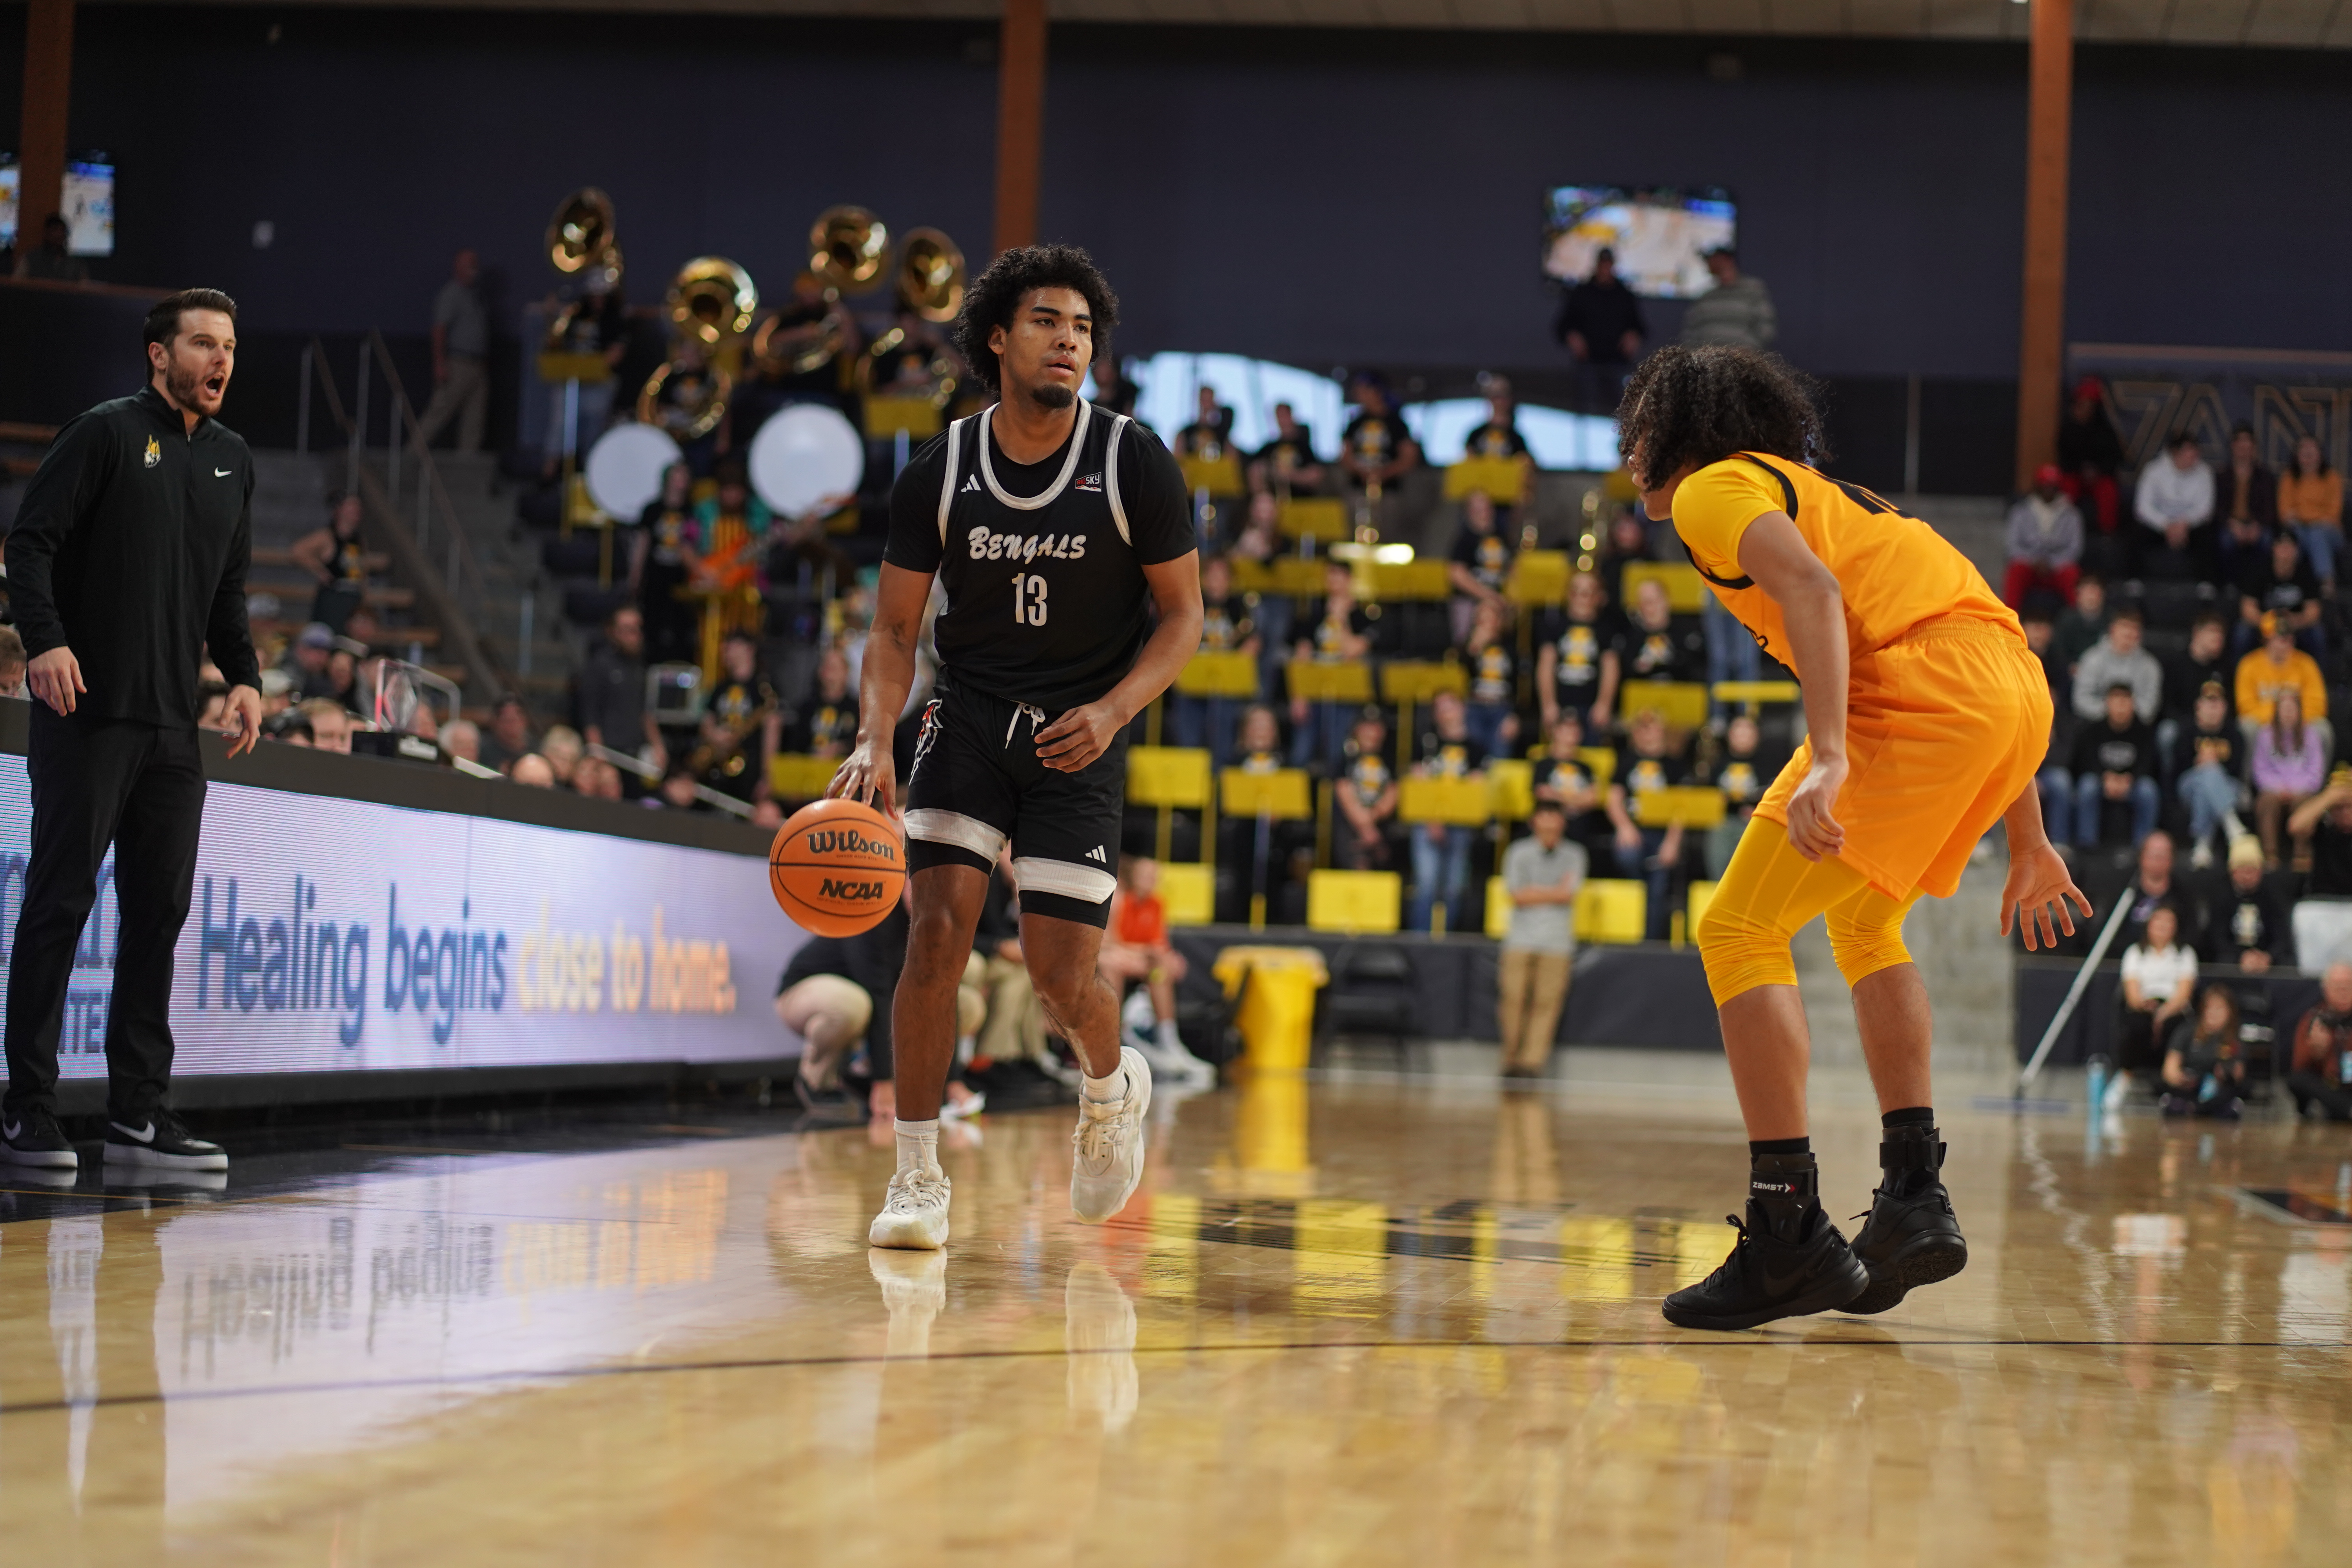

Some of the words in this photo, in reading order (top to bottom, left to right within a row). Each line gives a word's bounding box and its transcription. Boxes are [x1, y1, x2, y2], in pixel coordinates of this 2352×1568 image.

[968, 526, 1086, 564] BENGALS
[1011, 572, 1048, 626] 13
[807, 829, 895, 862] Wilson
[818, 878, 884, 900] NCAA
[198, 873, 369, 1049] Healing
[384, 880, 508, 1046] begins
[517, 898, 604, 1014] close
[610, 916, 644, 1013] to
[648, 903, 736, 1014] home.
